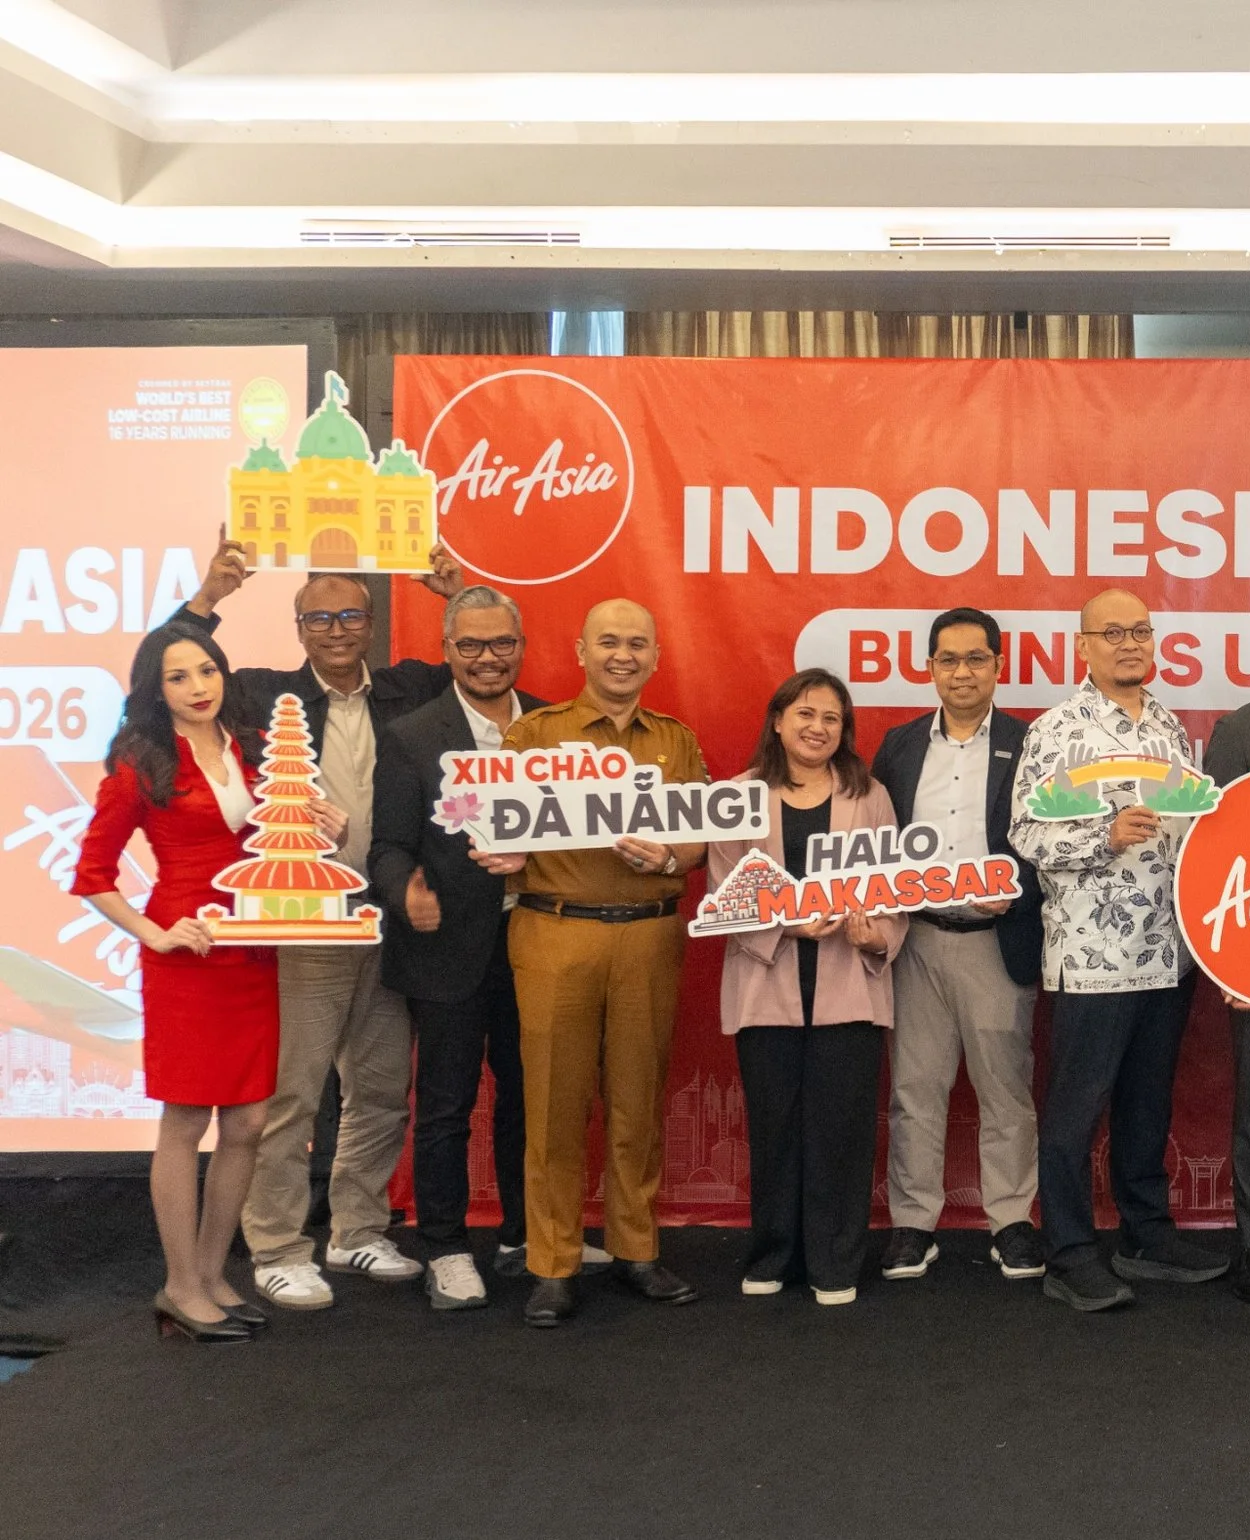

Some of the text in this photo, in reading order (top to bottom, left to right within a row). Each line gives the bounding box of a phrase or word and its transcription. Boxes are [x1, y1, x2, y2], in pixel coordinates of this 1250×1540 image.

[108, 408, 178, 423] LOW-COST
[181, 408, 231, 422] AIRLINE
[198, 391, 231, 405] BEST
[126, 426, 167, 439] YEARS
[171, 426, 231, 439] RUNNING
[849, 630, 1203, 688] BUINS
[451, 748, 627, 785] XIN CHÀO
[490, 785, 572, 841] ĐÀ
[811, 825, 939, 873] HALO
[757, 859, 1018, 923] MAKASSAR
